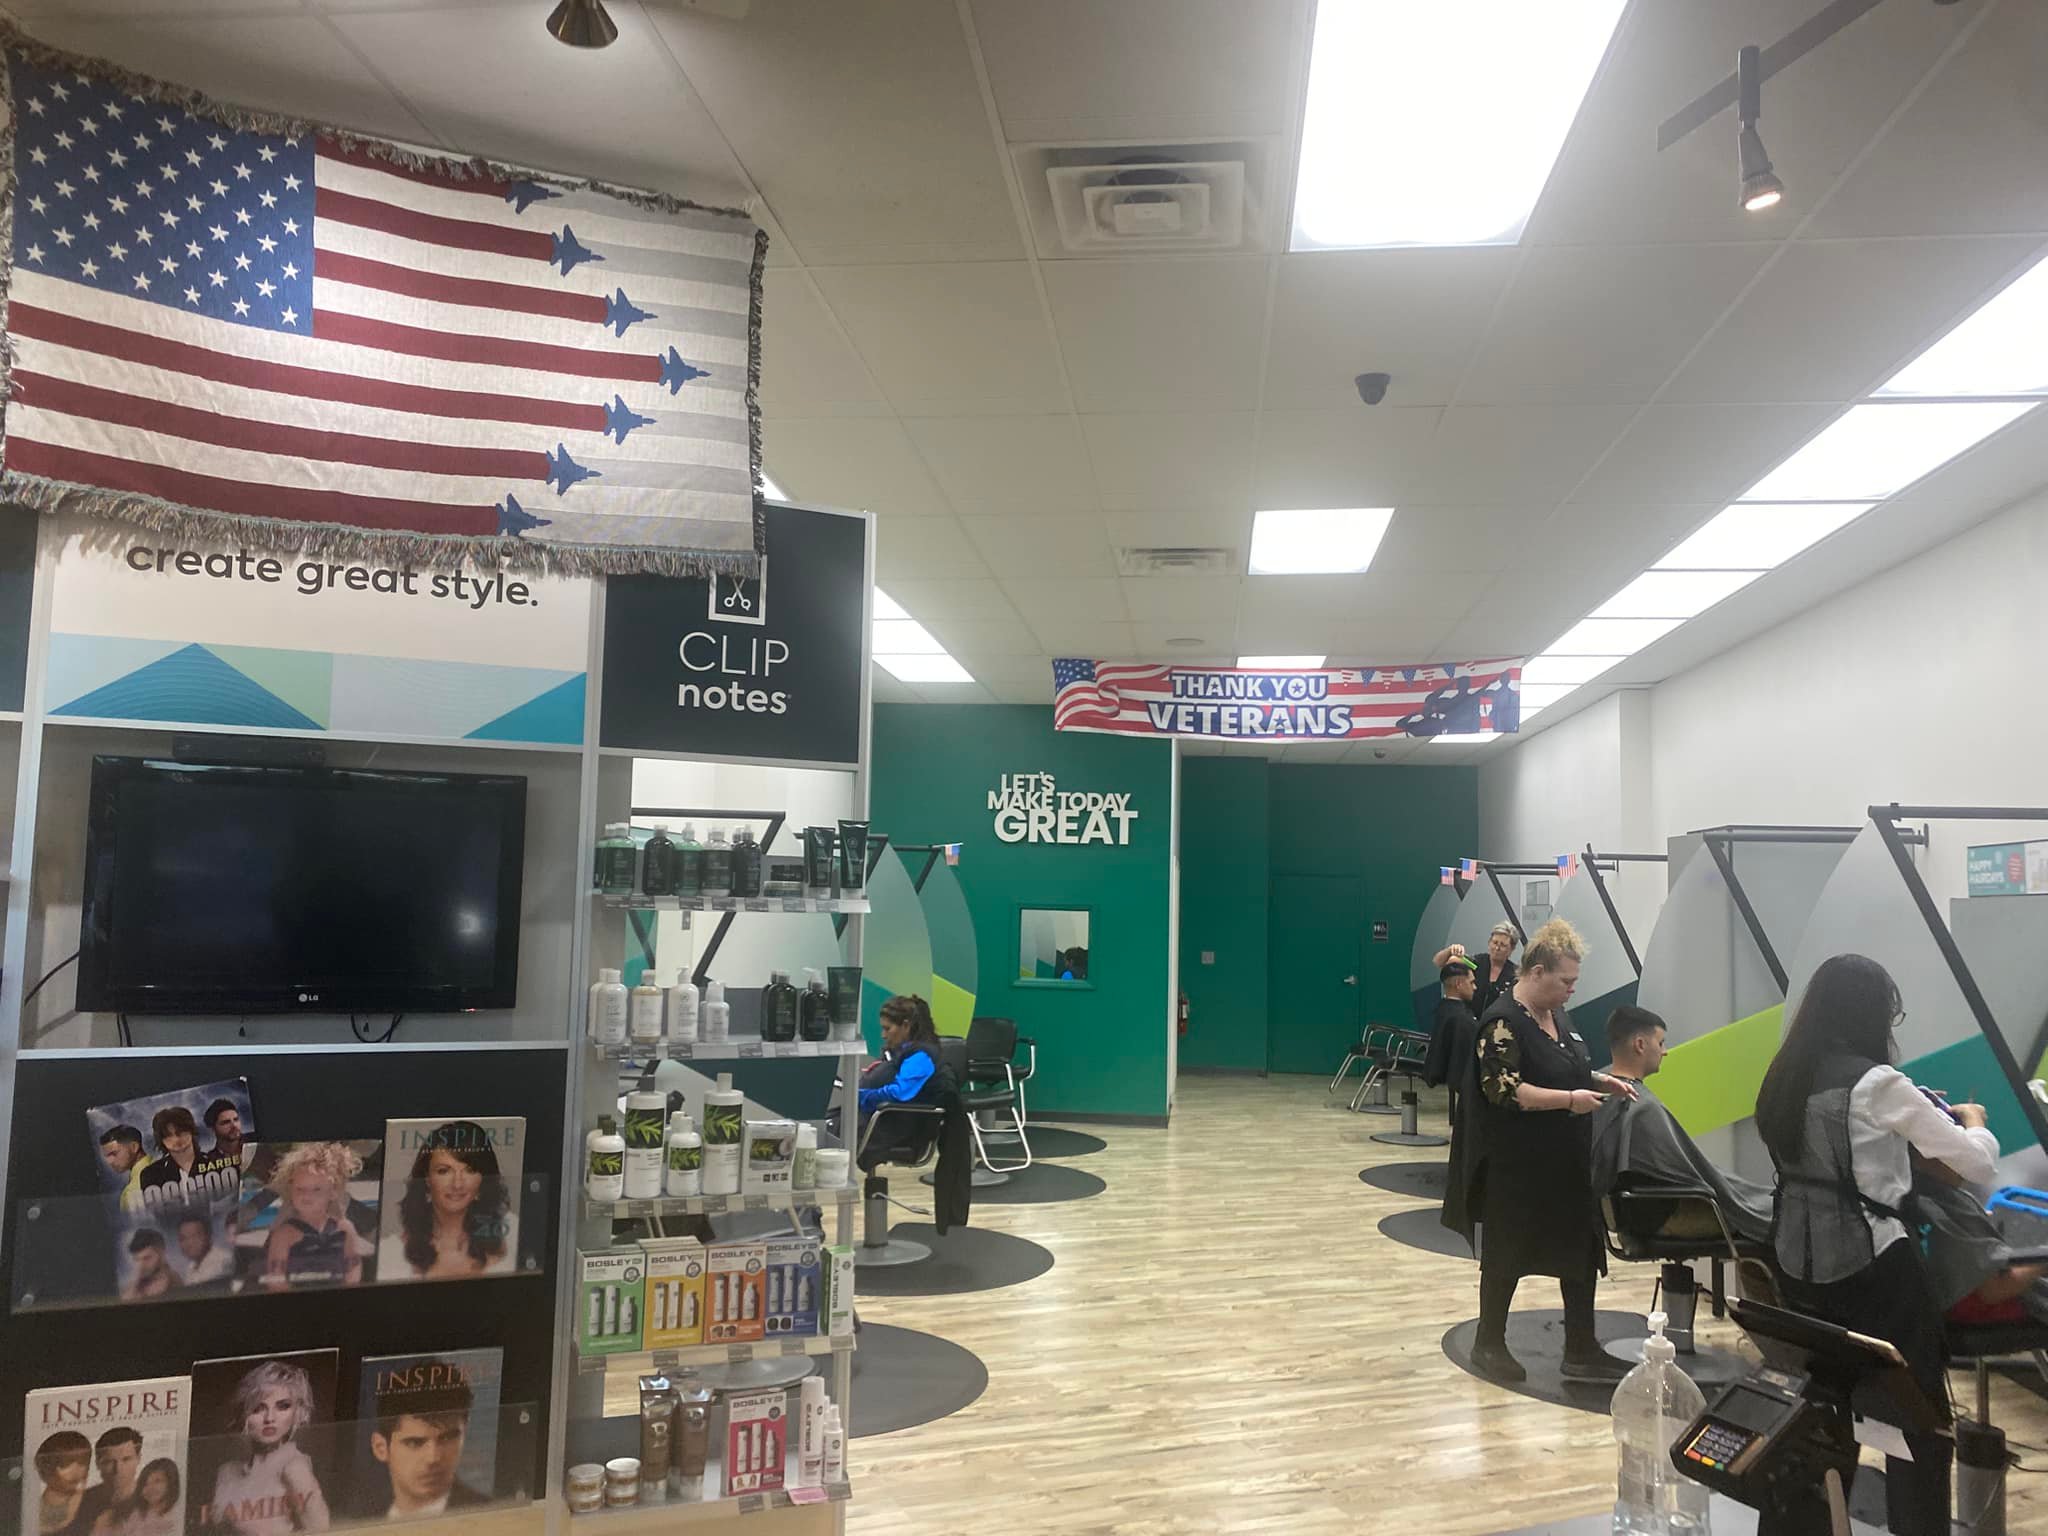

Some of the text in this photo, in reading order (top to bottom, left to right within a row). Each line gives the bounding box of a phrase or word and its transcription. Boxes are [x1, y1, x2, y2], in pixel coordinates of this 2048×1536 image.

[125, 545, 539, 610] create great style.
[679, 631, 790, 677] CLIP
[677, 681, 788, 715] notes
[1172, 673, 1327, 699] THANK YOU
[1147, 703, 1353, 734] VETERANS
[1001, 771, 1056, 793] LET'S
[987, 790, 1131, 812] MAKE TODAY
[994, 808, 1139, 846] GREAT
[400, 1127, 516, 1150] INSPIRE
[587, 1258, 631, 1268] BOSLEY
[651, 1255, 692, 1264] BOSLEY
[711, 1250, 754, 1259] BOSLEY
[832, 1269, 840, 1310] BOSLEY
[375, 1360, 497, 1391] INSPIRE
[42, 1390, 179, 1424] INSPIRE
[732, 1396, 775, 1409] BOSLEY
